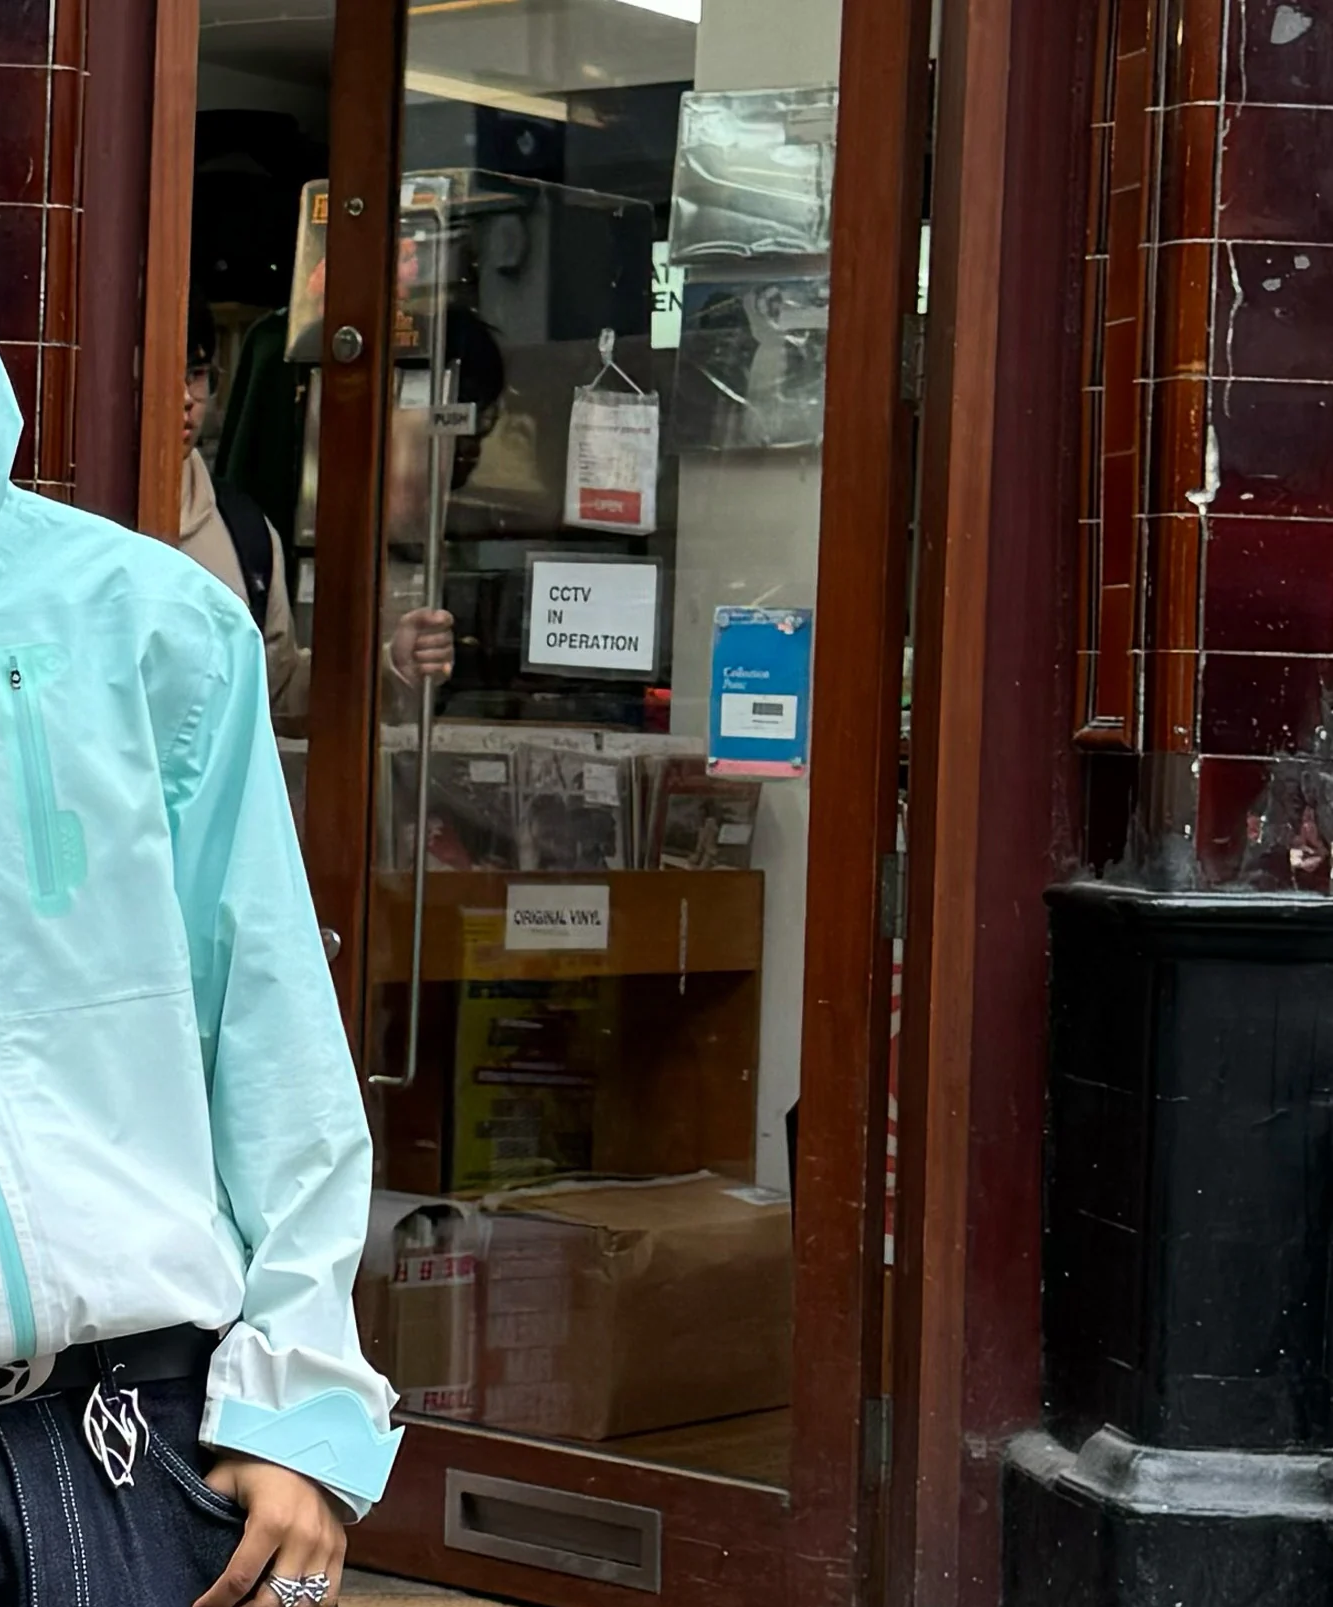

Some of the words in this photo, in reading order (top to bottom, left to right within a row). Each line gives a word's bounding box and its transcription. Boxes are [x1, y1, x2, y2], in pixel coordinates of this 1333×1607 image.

[549, 585, 592, 602] CCTV
[547, 608, 563, 625] IN
[546, 631, 639, 652] OPERATION
[513, 909, 567, 926] ORIGINAL
[569, 909, 601, 926] VINYL
